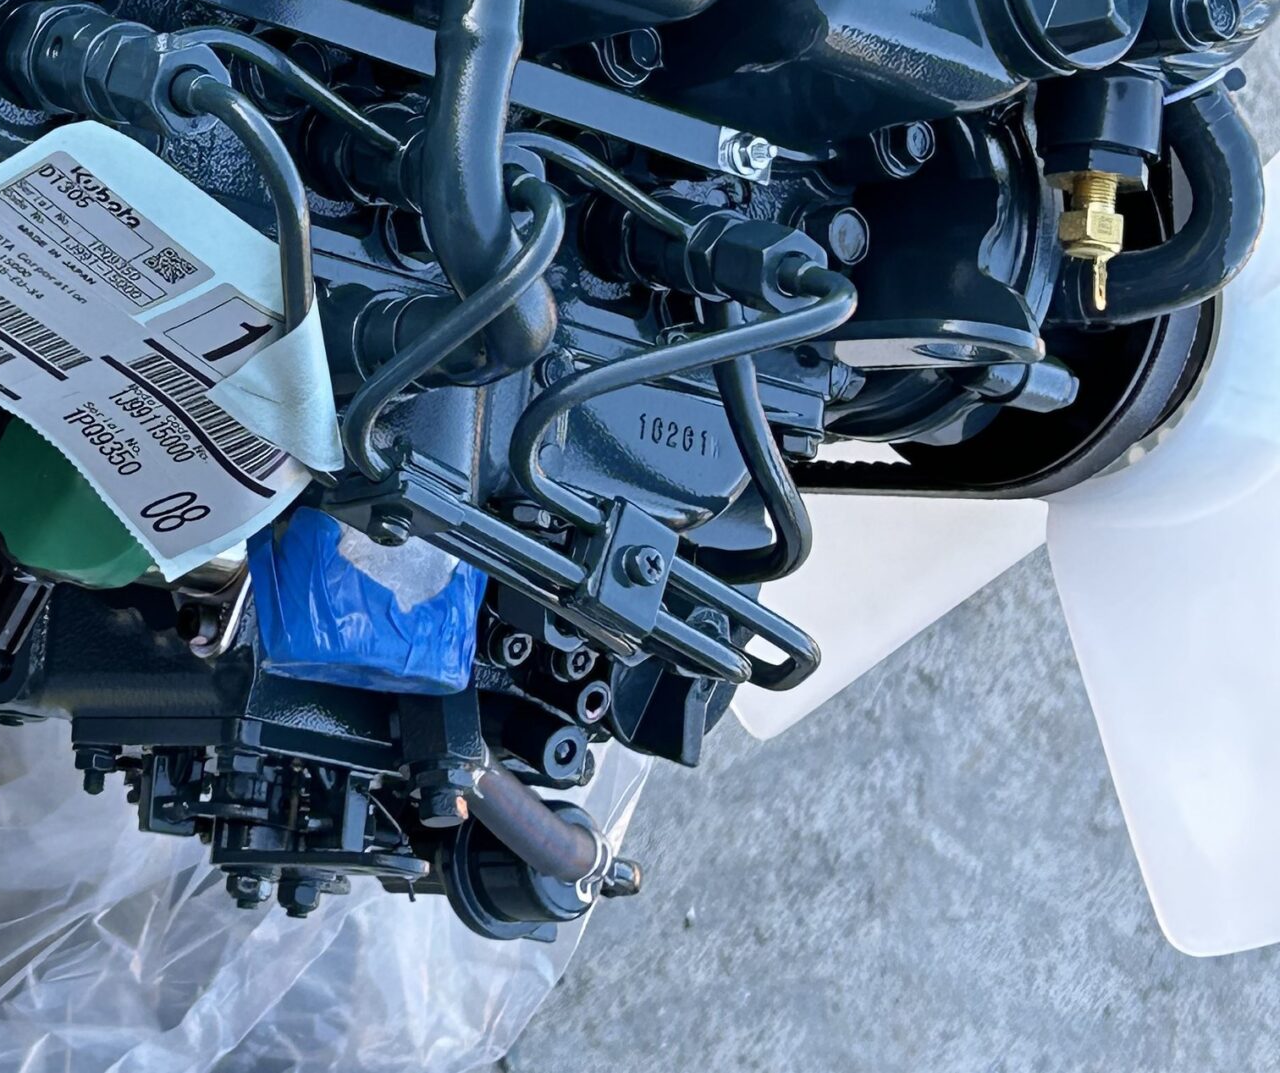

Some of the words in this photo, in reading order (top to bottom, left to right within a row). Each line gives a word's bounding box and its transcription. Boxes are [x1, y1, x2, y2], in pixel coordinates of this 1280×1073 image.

[39, 163, 96, 208] D1305
[70, 166, 141, 229] Kubota
[16, 223, 48, 248] MADE
[47, 247, 63, 258] IN
[63, 260, 97, 285] JAPAN
[17, 252, 88, 304] Corporation
[201, 322, 274, 362] 1
[63, 408, 142, 475] 1PQ9350
[140, 491, 211, 533] 08
